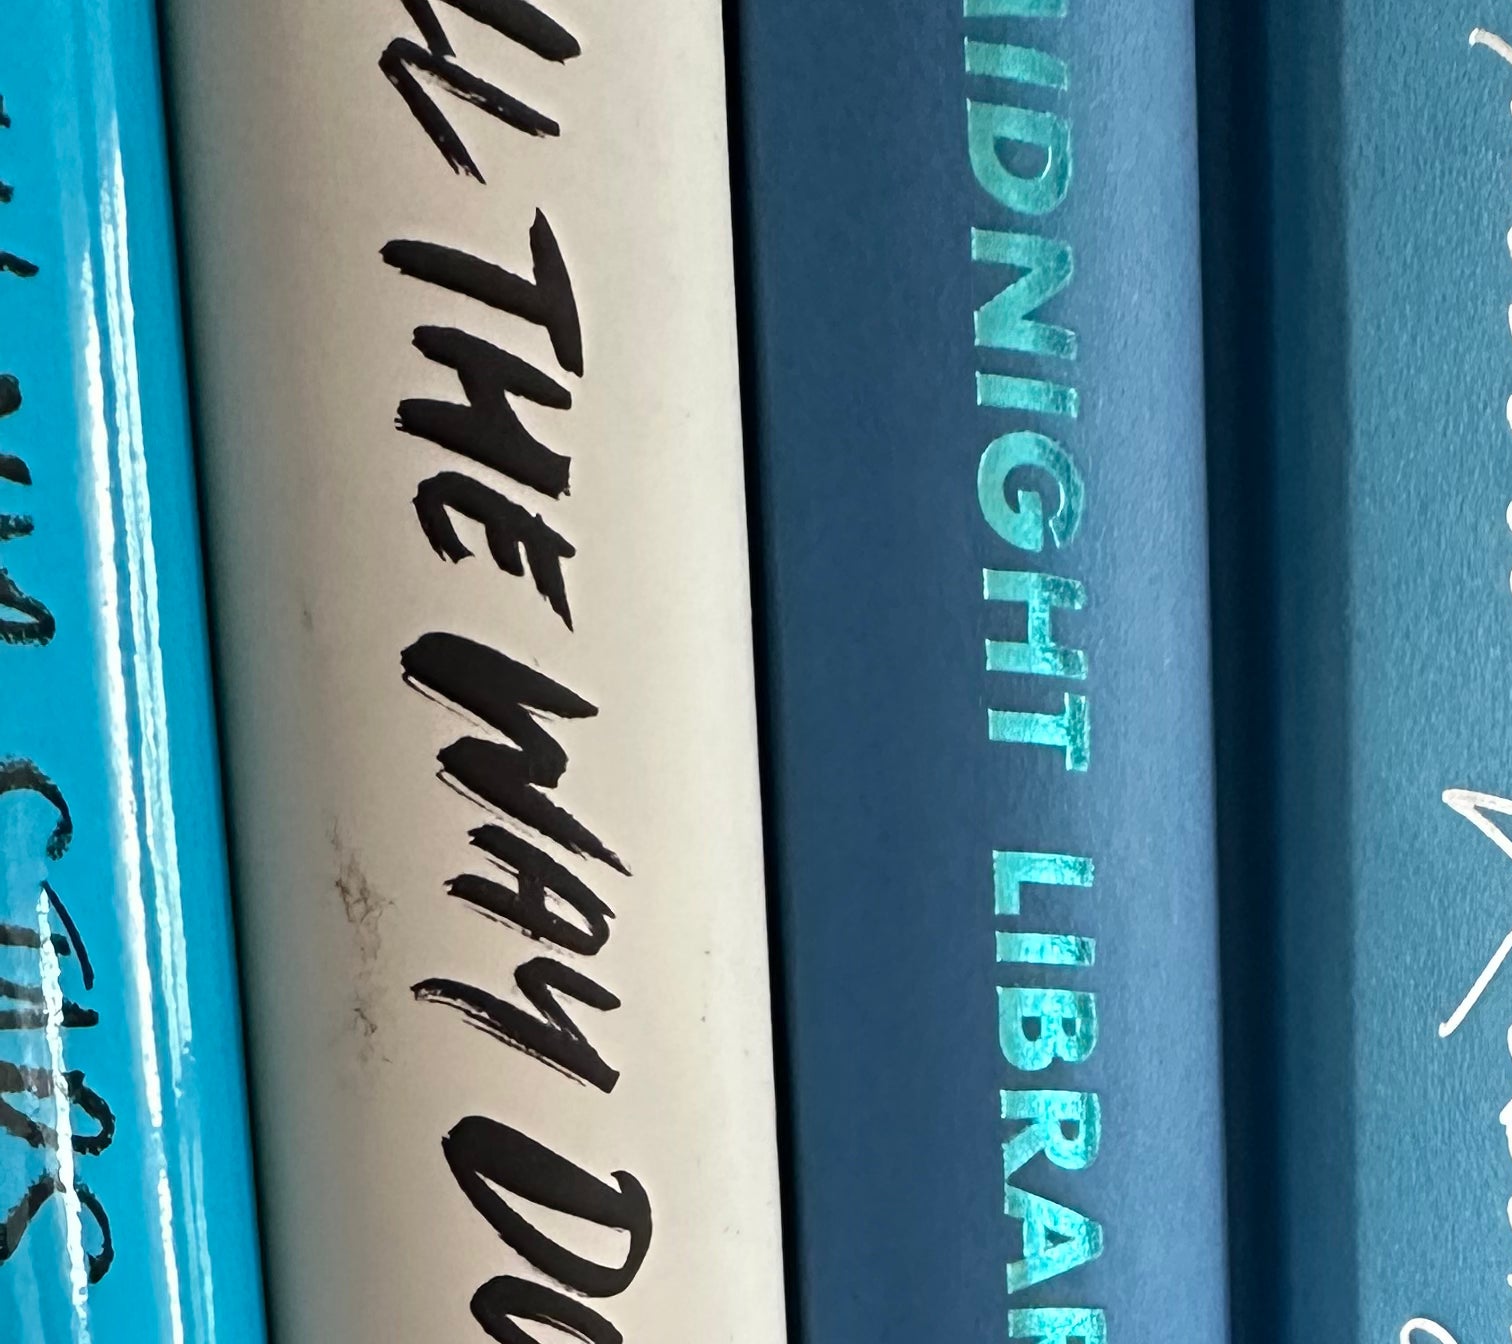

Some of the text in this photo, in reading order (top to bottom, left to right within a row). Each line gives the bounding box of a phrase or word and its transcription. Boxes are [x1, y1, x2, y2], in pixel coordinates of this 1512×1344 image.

[379, 0, 580, 184] LL
[379, 208, 583, 631] THE
[967, 0, 1092, 774] IDNIGHT
[401, 632, 631, 1093] WAY
